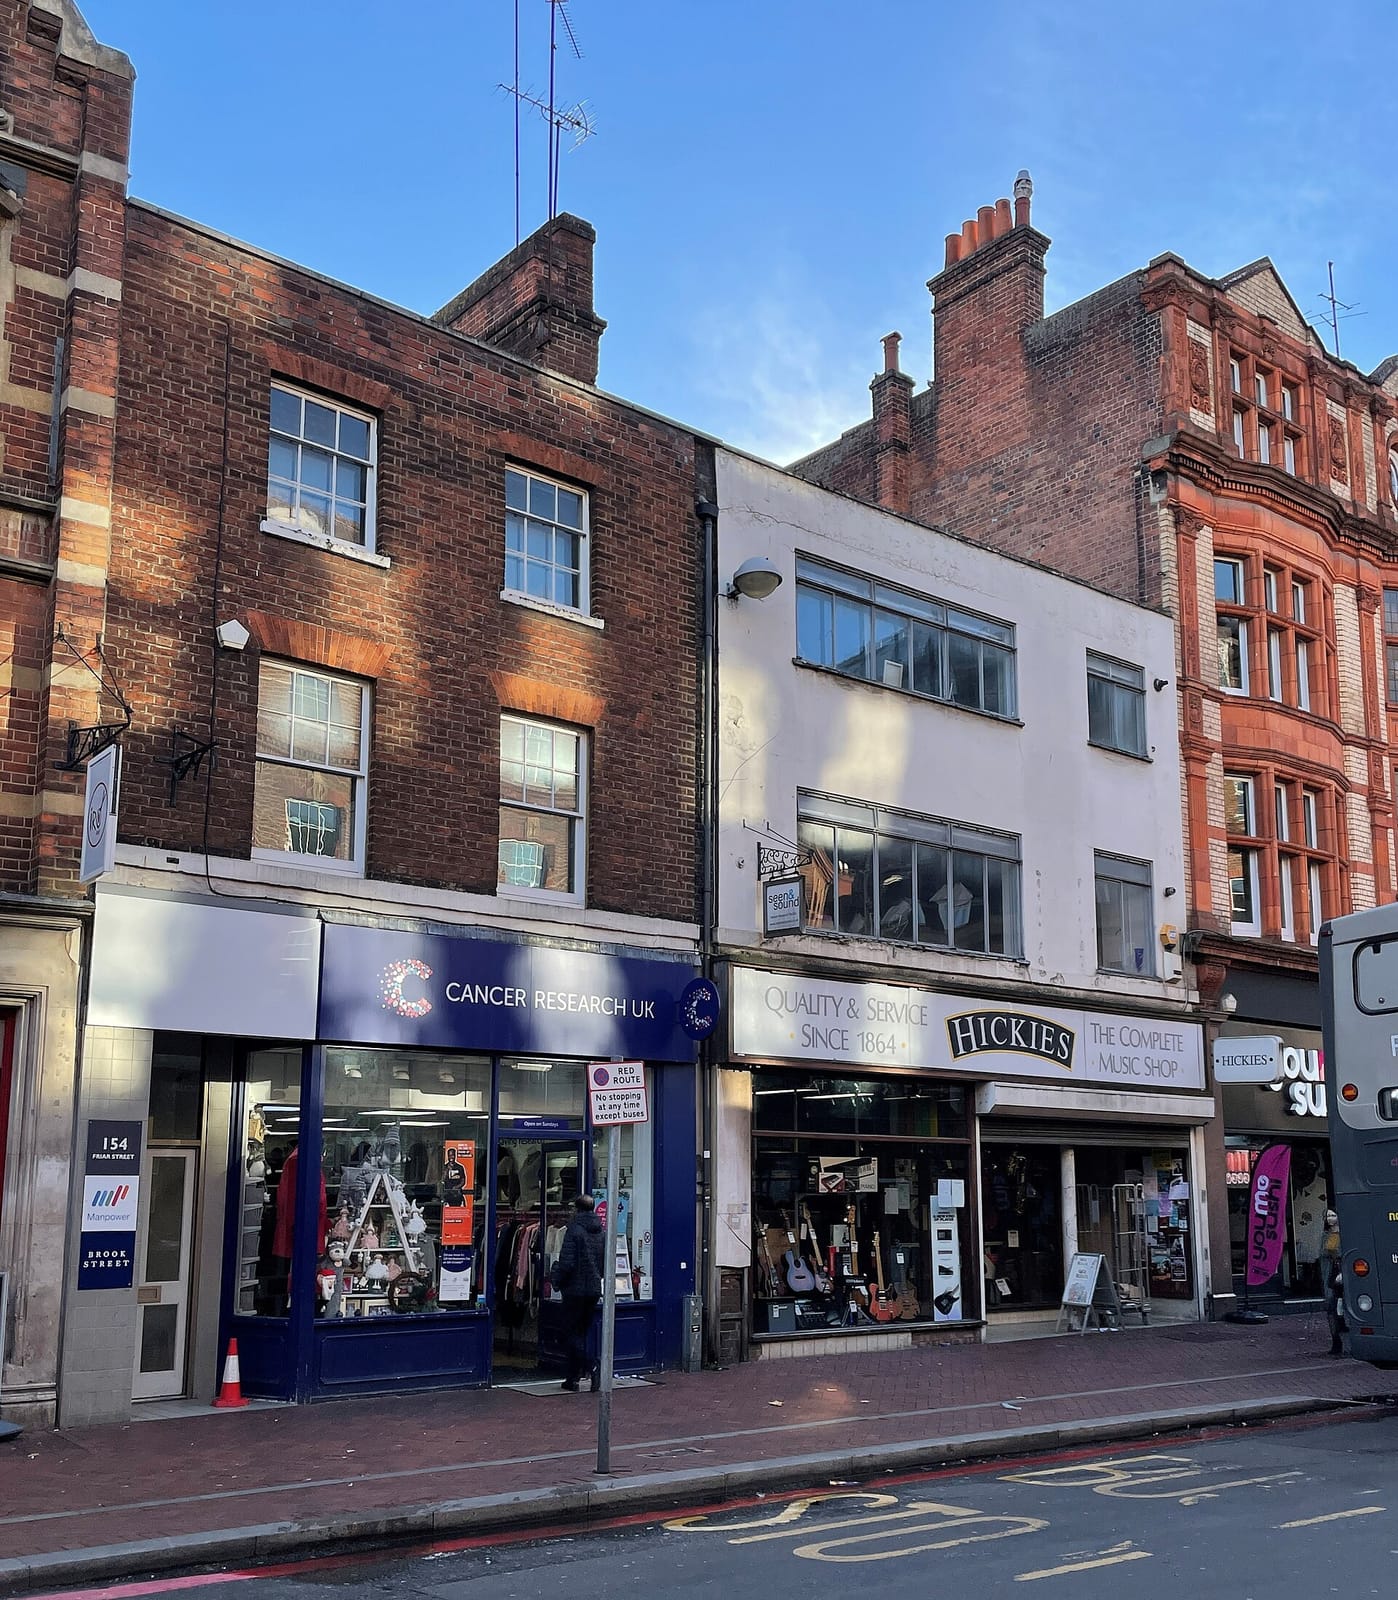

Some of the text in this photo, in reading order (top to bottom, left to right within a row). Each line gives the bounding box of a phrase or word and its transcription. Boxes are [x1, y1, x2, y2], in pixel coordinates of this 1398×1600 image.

[773, 897, 799, 910] sound
[445, 982, 655, 1019] CANCER RESEARCH UK
[764, 986, 928, 1026] QUALITY & SERVICE
[801, 1024, 896, 1054] SINCE 1864
[951, 1016, 1071, 1061] HICKIES
[1090, 1022, 1184, 1052] THE COMPLETE
[1099, 1053, 1178, 1079] MUSIC SHOP
[1221, 1054, 1268, 1067] HICKIES
[617, 1066, 635, 1075] RED
[613, 1075, 641, 1085] ROUTE
[595, 1092, 641, 1102] No stopping
[595, 1110, 645, 1120] except buses
[523, 1120, 536, 1128] Open
[103, 1137, 128, 1151] 154
[1266, 1179, 1282, 1241] sushi
[86, 1213, 130, 1222] Manpower
[87, 1250, 127, 1258] BROOK
[82, 1259, 130, 1268] STREET
